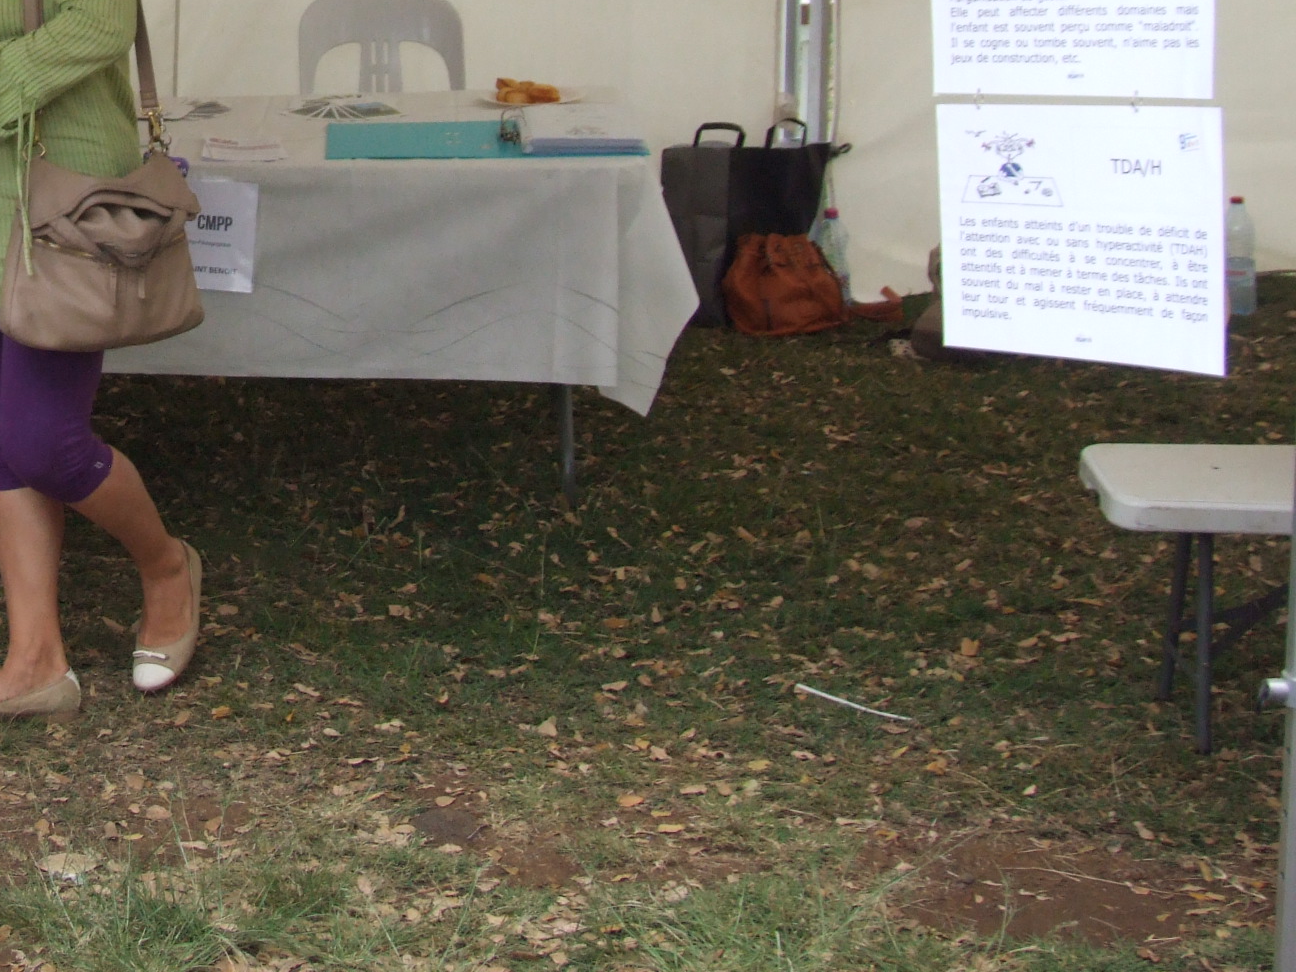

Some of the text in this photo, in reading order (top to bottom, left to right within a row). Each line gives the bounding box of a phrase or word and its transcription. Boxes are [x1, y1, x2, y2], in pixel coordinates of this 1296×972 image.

[949, 4, 1198, 18] Elle peut affecter différents domaines mais
[950, 21, 988, 32] l'enfant
[992, 23, 1008, 32] est
[1014, 22, 1054, 32] souvent
[1060, 23, 1089, 34] perçu
[1094, 22, 1133, 32] comme
[950, 36, 958, 48] Il
[962, 39, 975, 48] se
[979, 39, 1010, 50] cogne
[1014, 38, 1028, 48] ou
[1033, 37, 1067, 48] tombe
[1122, 37, 1158, 48] n'aime
[1162, 38, 1181, 49] pas
[1185, 37, 1200, 48] les
[950, 54, 972, 65] jeux
[975, 52, 989, 63] de
[1110, 158, 1162, 177] TDA/H
[197, 214, 233, 231] CMPP
[959, 216, 1207, 240] Les enfants atteints d'un trouble de déficit de
[959, 230, 1010, 243] l'attention
[1016, 235, 1040, 245] avec
[1045, 237, 1059, 246] ou
[1065, 238, 1089, 248] sans
[959, 247, 976, 256] ont
[984, 247, 1003, 258] des
[1011, 248, 1060, 262] difficultés
[1068, 251, 1076, 263] à
[1083, 255, 1096, 264] se
[1170, 258, 1179, 270] à
[1186, 259, 1208, 273] être
[960, 262, 1002, 273] attentifs
[1004, 264, 1016, 274] et
[1018, 264, 1026, 275] à
[1029, 267, 1062, 277] mener
[1065, 267, 1072, 278] à
[1075, 269, 1108, 281] terme
[1111, 271, 1130, 282] des
[1175, 275, 1188, 287] Ils
[1190, 279, 1208, 289] ont
[960, 277, 1000, 288] souvent
[1005, 279, 1018, 290] du
[1024, 281, 1043, 291] mal
[1048, 281, 1055, 292] à
[1060, 285, 1092, 295] rester
[1096, 287, 1110, 296] en
[1152, 289, 1159, 301] à
[1164, 293, 1208, 306] attendre
[961, 291, 1208, 323] leur tour et agissent fréquemment de façon
